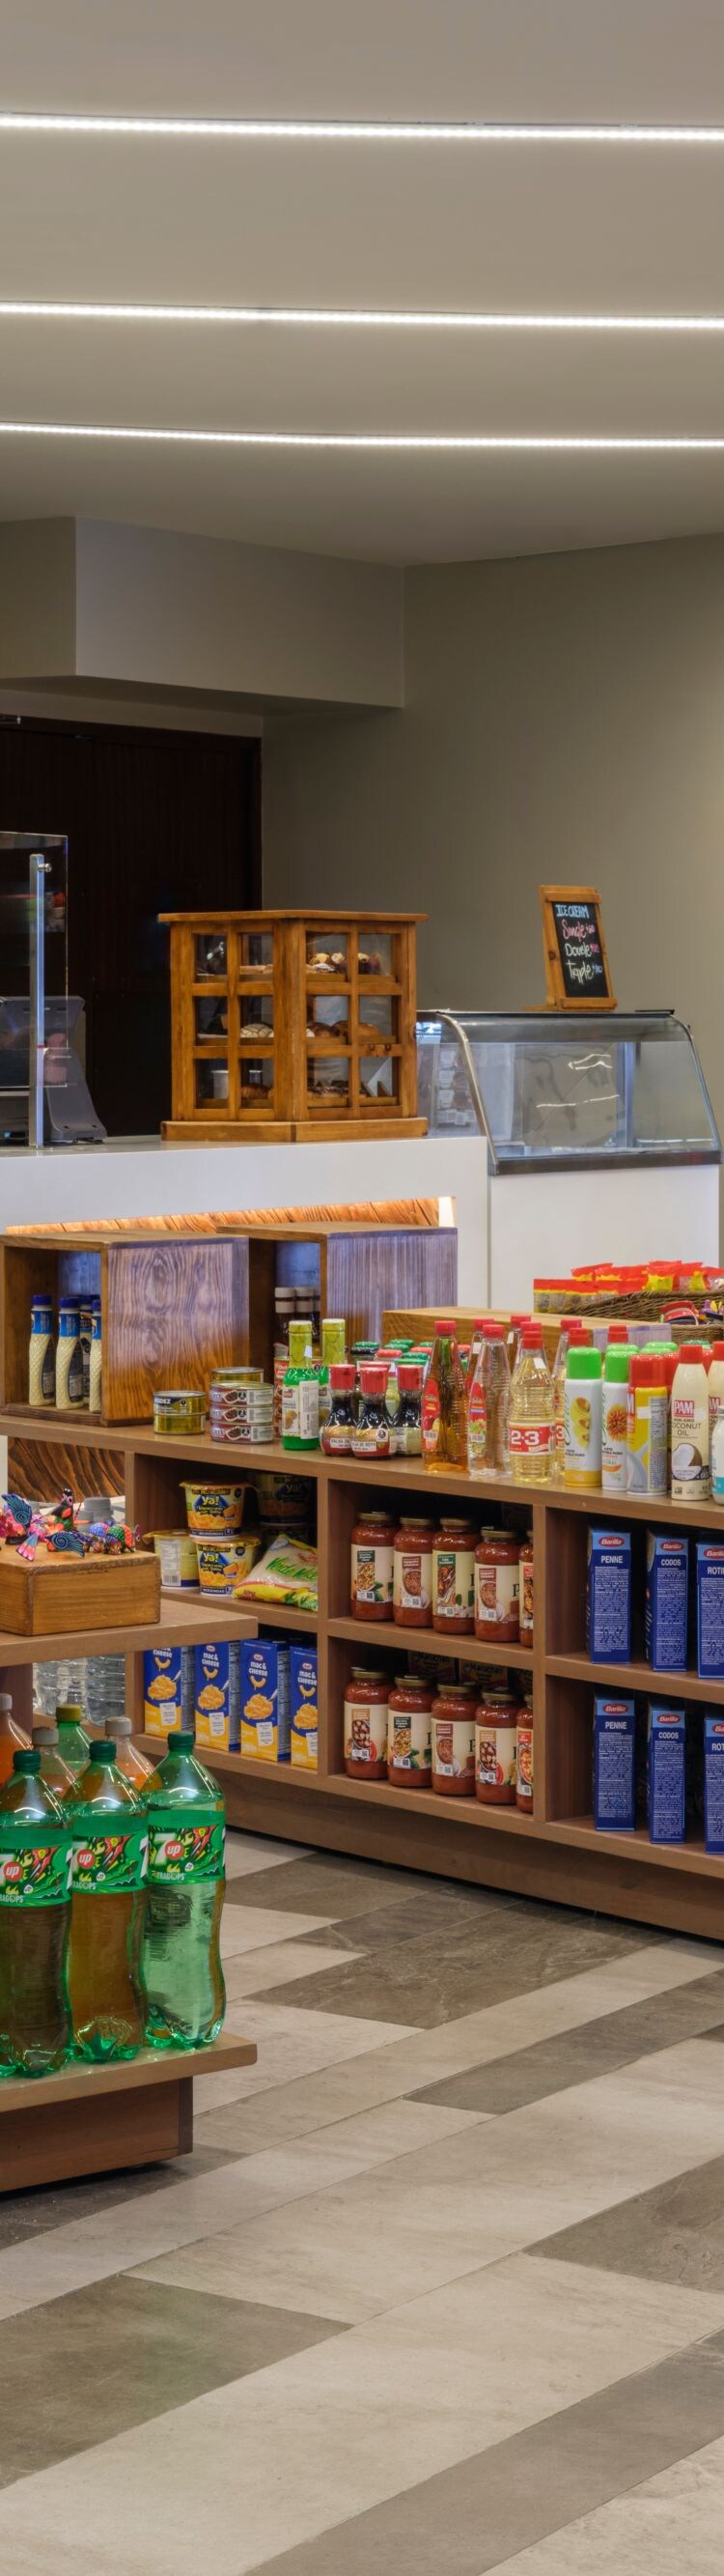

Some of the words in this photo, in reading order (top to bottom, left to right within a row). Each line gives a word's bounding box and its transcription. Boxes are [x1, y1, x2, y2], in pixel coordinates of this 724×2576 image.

[555, 904, 568, 917] ICE
[568, 905, 590, 919] CREAM
[565, 942, 592, 957] Double
[674, 1401, 694, 1415] PAM
[600, 1555, 624, 1564] PENNE
[604, 1721, 627, 1730] PENNE
